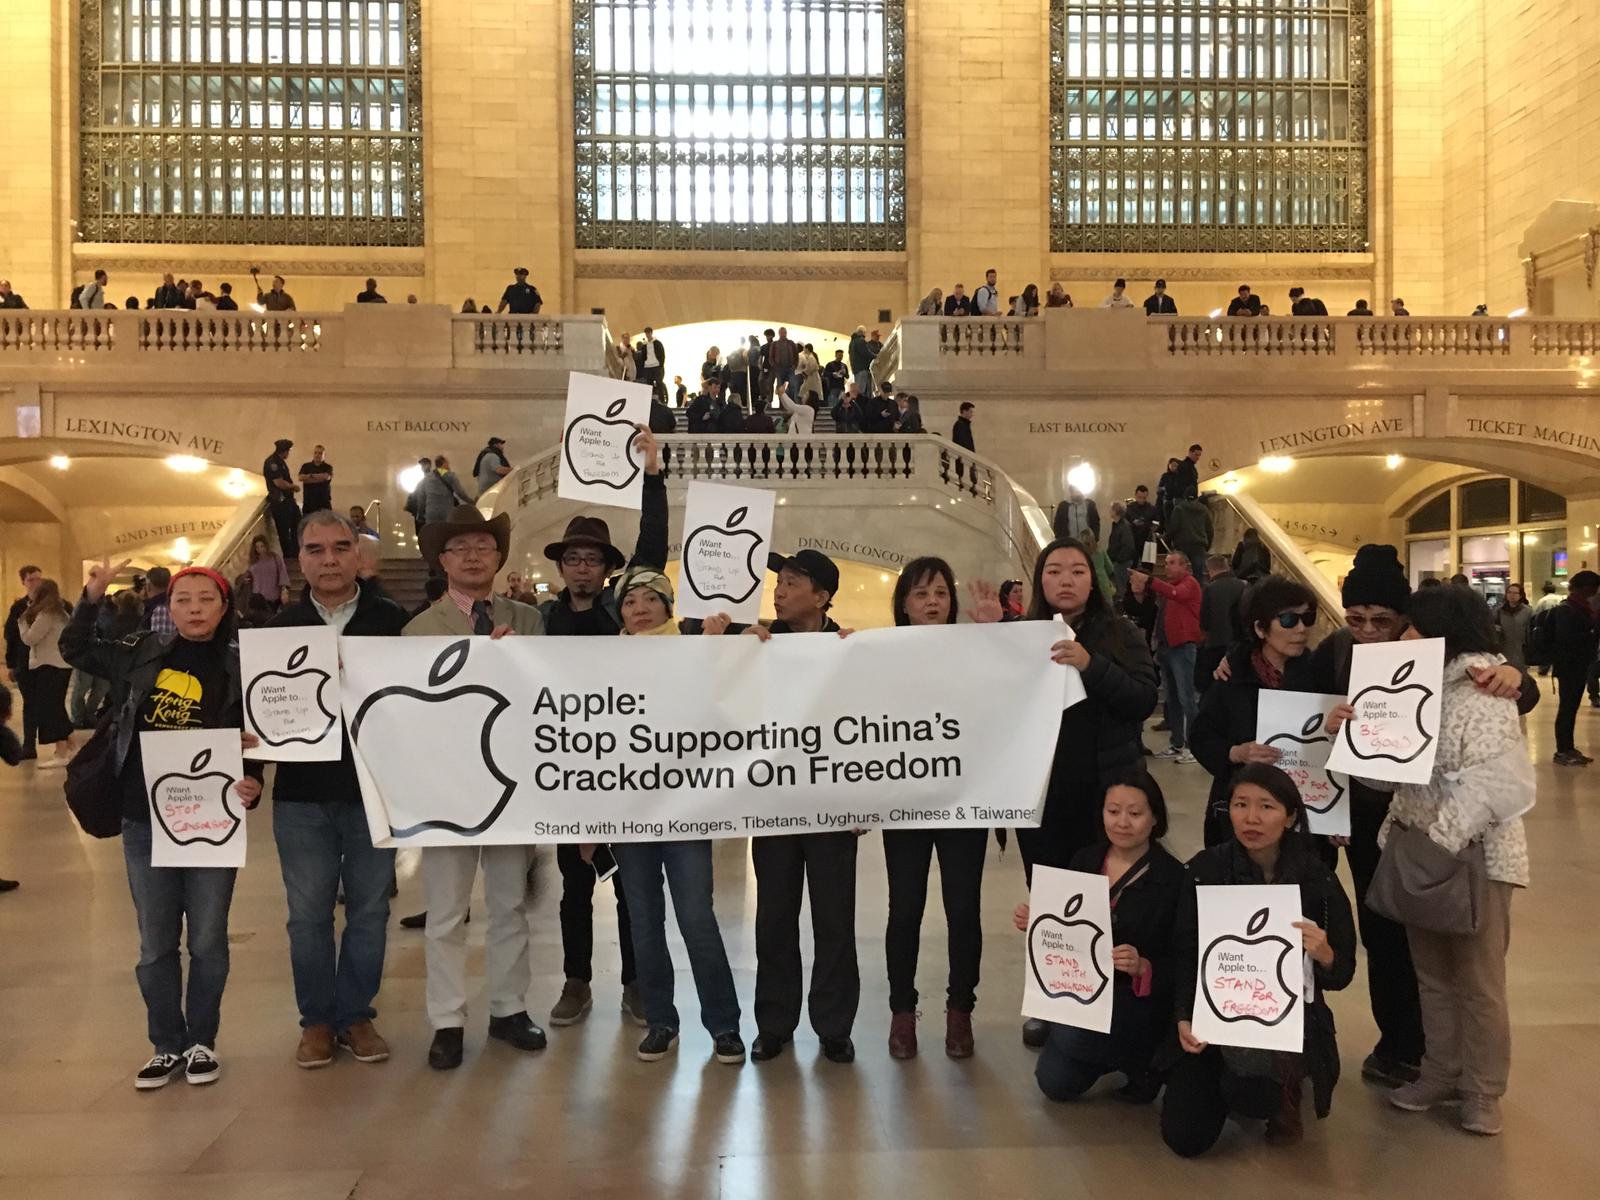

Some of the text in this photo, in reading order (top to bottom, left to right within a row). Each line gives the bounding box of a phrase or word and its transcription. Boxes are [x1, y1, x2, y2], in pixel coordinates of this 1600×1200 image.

[367, 420, 471, 433] EAST BALCONY
[1028, 421, 1128, 433] EAST BALCONY
[1466, 418, 1527, 436] TICKET
[66, 417, 224, 454] LEXINGTON AVE
[579, 436, 602, 447] Apple
[1259, 418, 1404, 454] LEXINGTON AVE
[115, 529, 148, 545] 42ND
[151, 521, 196, 536] STREET
[699, 539, 722, 549] iWant
[798, 537, 850, 553] DINING
[698, 548, 722, 558] Apple
[261, 685, 286, 695] iWant
[261, 694, 288, 704] Apple
[532, 686, 646, 722] Apple:
[1362, 701, 1387, 710] iWant
[1363, 710, 1388, 720] Apple
[534, 712, 961, 760] Stop Supporting China's
[534, 751, 962, 791] Crackdown On Freedom
[167, 794, 193, 802] Apple
[165, 803, 201, 817] STOP
[534, 821, 580, 836] Stand
[585, 821, 617, 835] with
[621, 821, 663, 837] Hong
[669, 819, 737, 836] Kongers,
[741, 815, 812, 830] Tibetans,
[816, 812, 884, 827] Uyghurs,
[889, 807, 951, 822] Chinese
[956, 809, 967, 821] &
[1041, 929, 1063, 941] iWant
[1041, 938, 1065, 950] Apple
[1044, 953, 1079, 969] STAND
[1217, 952, 1244, 962] iWant
[1217, 962, 1245, 973] Apple
[1214, 976, 1266, 991] STAND
[1252, 991, 1278, 1003] FOR
[1222, 1000, 1279, 1016] FREEDOM
